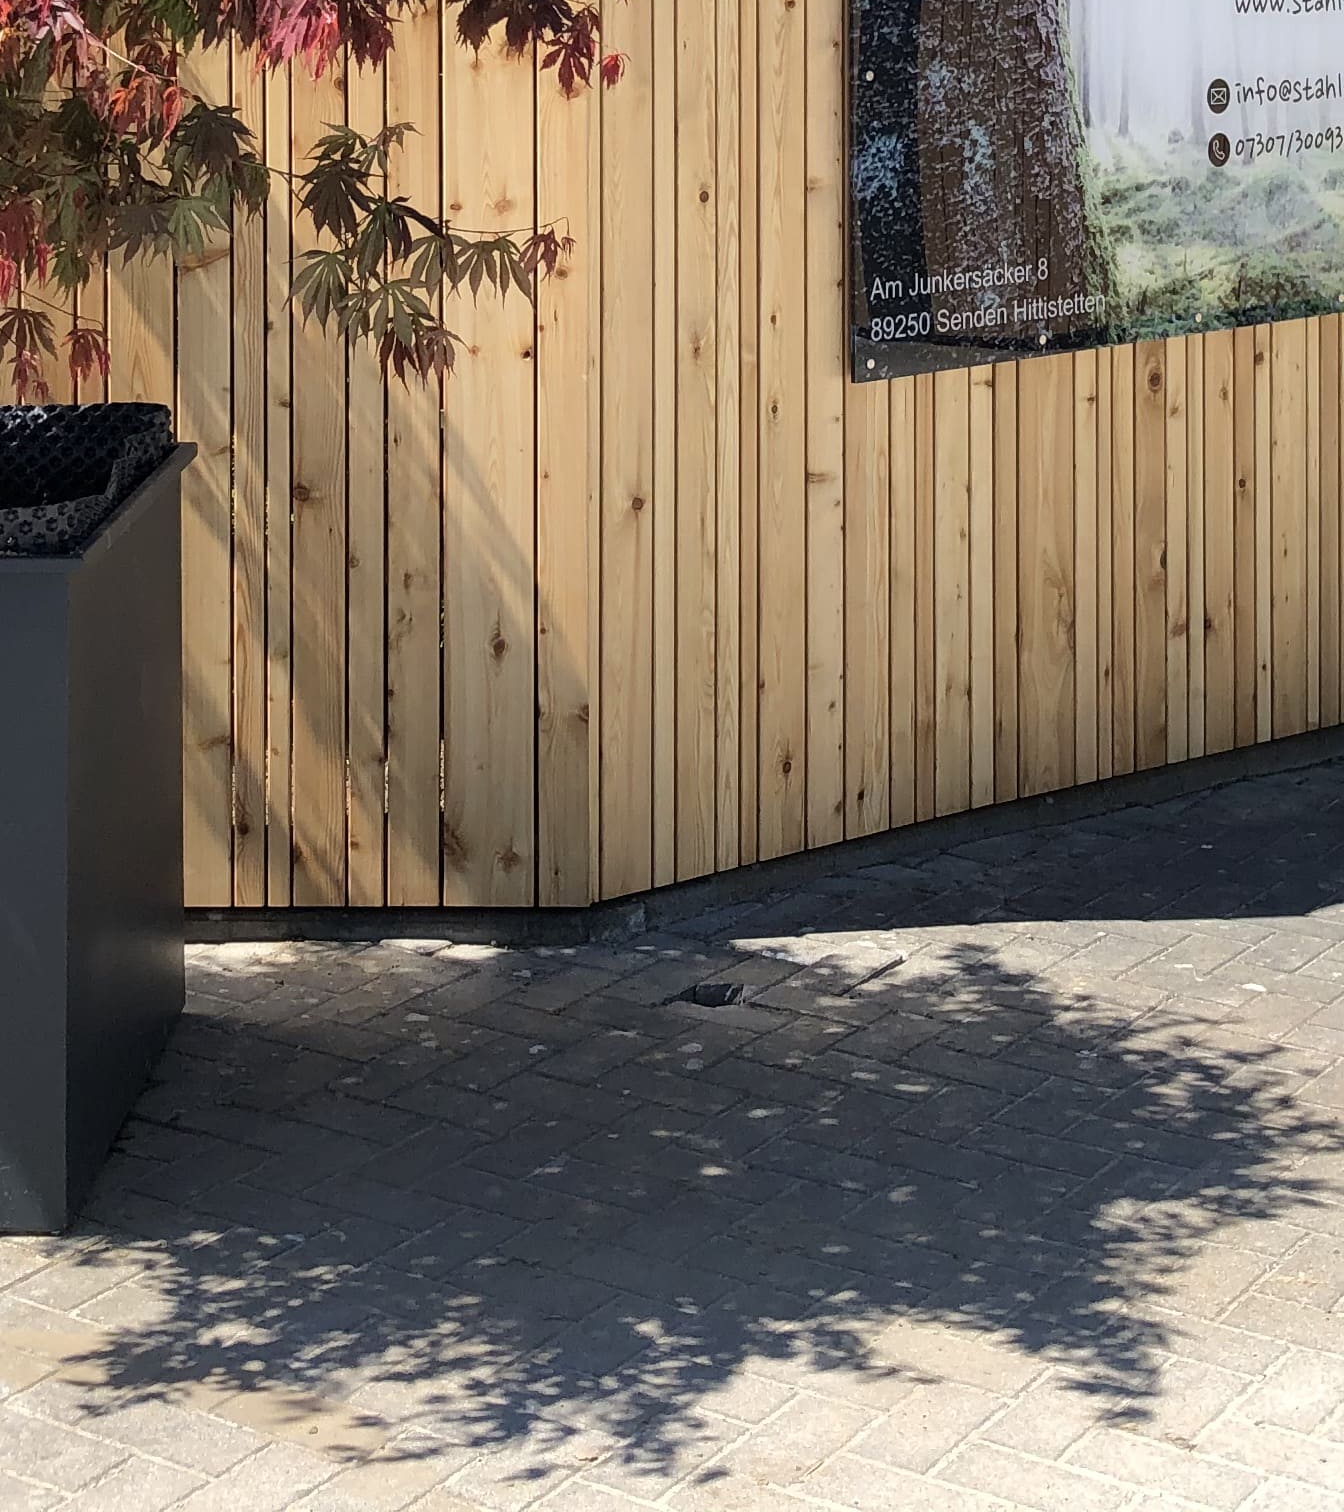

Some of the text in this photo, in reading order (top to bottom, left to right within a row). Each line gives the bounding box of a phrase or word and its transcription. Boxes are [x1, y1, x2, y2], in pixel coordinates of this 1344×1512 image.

[870, 257, 1049, 301] Am Junkersäcker 8
[870, 292, 1106, 342] 89250 Senden Hittistetten
